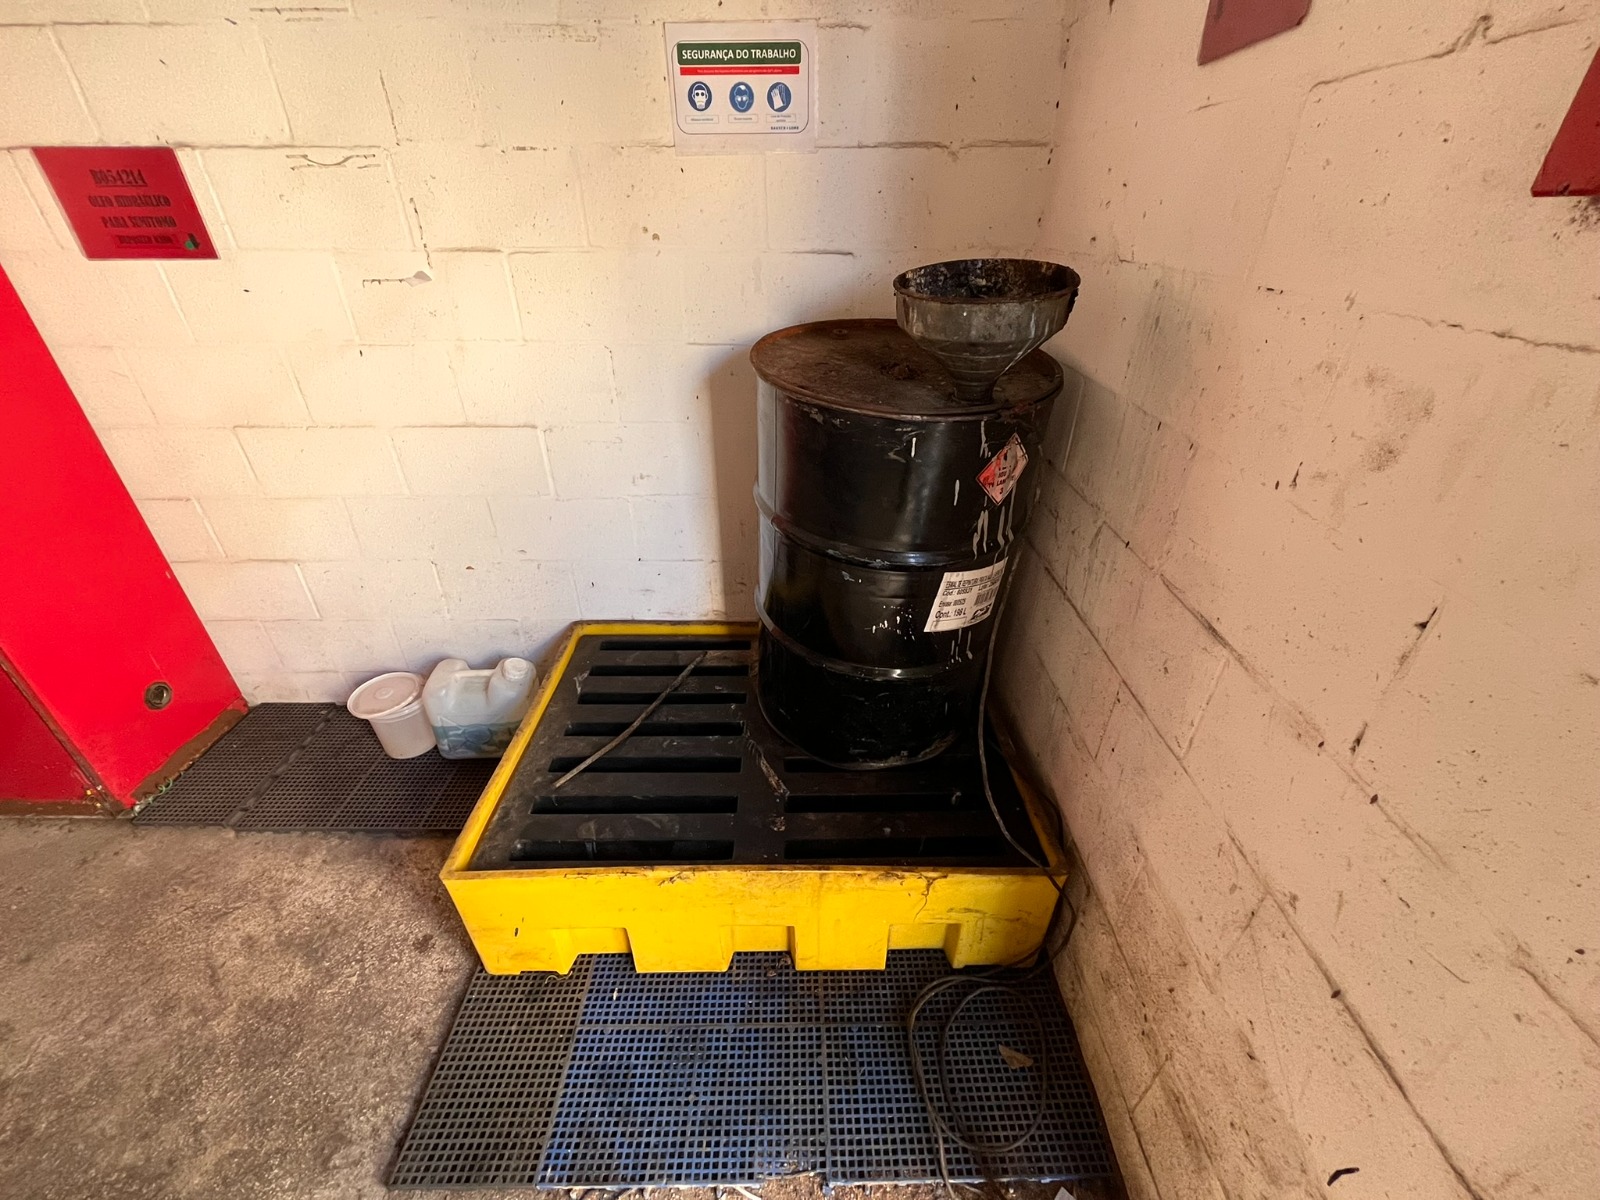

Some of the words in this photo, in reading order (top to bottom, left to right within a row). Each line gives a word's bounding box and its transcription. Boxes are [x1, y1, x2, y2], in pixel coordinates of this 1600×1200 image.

[682, 49, 734, 61] SEGURANÇA
[735, 49, 749, 59] DO
[751, 49, 796, 59] TRABALHO
